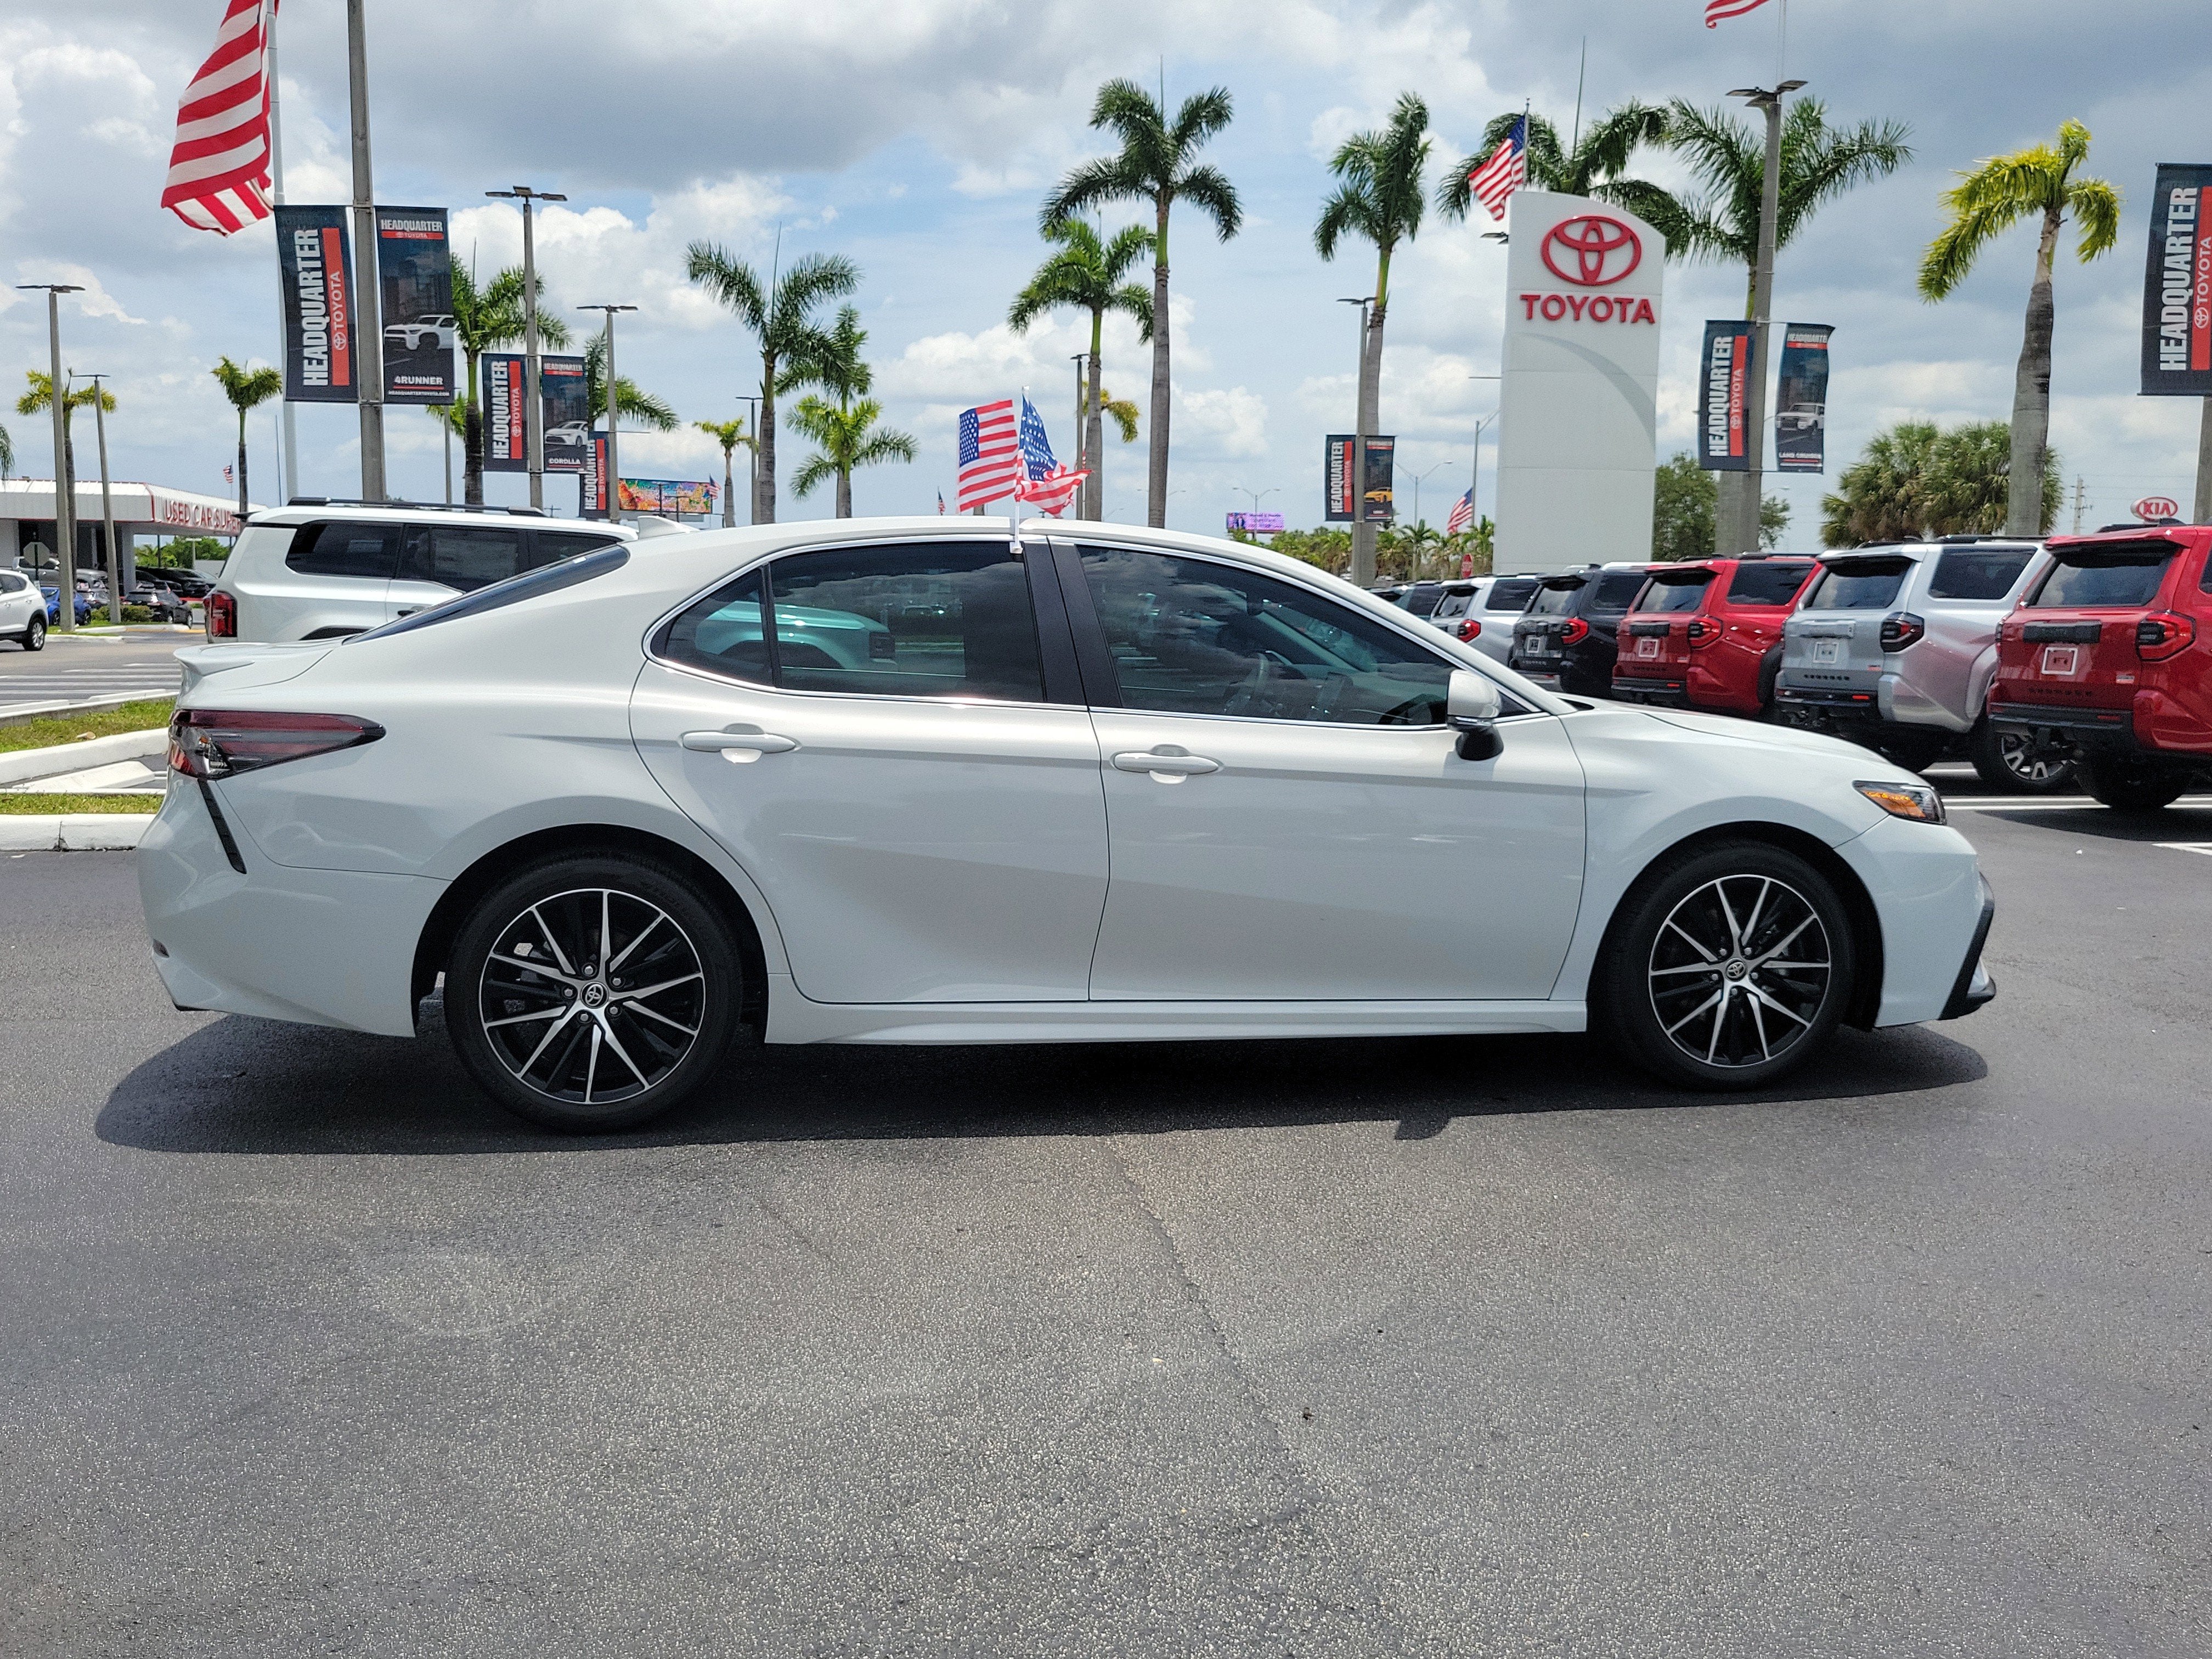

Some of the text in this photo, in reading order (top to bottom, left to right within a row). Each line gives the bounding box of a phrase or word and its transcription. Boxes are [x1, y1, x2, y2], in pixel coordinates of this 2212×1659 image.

[381, 220, 443, 232] HEADQUARTER
[2160, 187, 2198, 371] HEADQUARTER
[2197, 236, 2211, 305] TOYOTA
[294, 228, 330, 386] HEADQUARTER
[330, 271, 344, 330] TOYOTA
[1520, 295, 1655, 324] TOYOTA
[394, 376, 443, 385] 4RUNNER
[492, 360, 510, 459] HEADQUARTER
[511, 387, 521, 425] TOYOTA
[1708, 336, 1733, 456] HEADQUARTER
[1731, 369, 1743, 412] TOYOTA
[584, 439, 597, 510] HEADQUARTER
[1330, 442, 1344, 513] HEADQUARTER
[165, 499, 190, 523] USED
[194, 505, 213, 526] CAR
[2143, 502, 2171, 515] KIA
